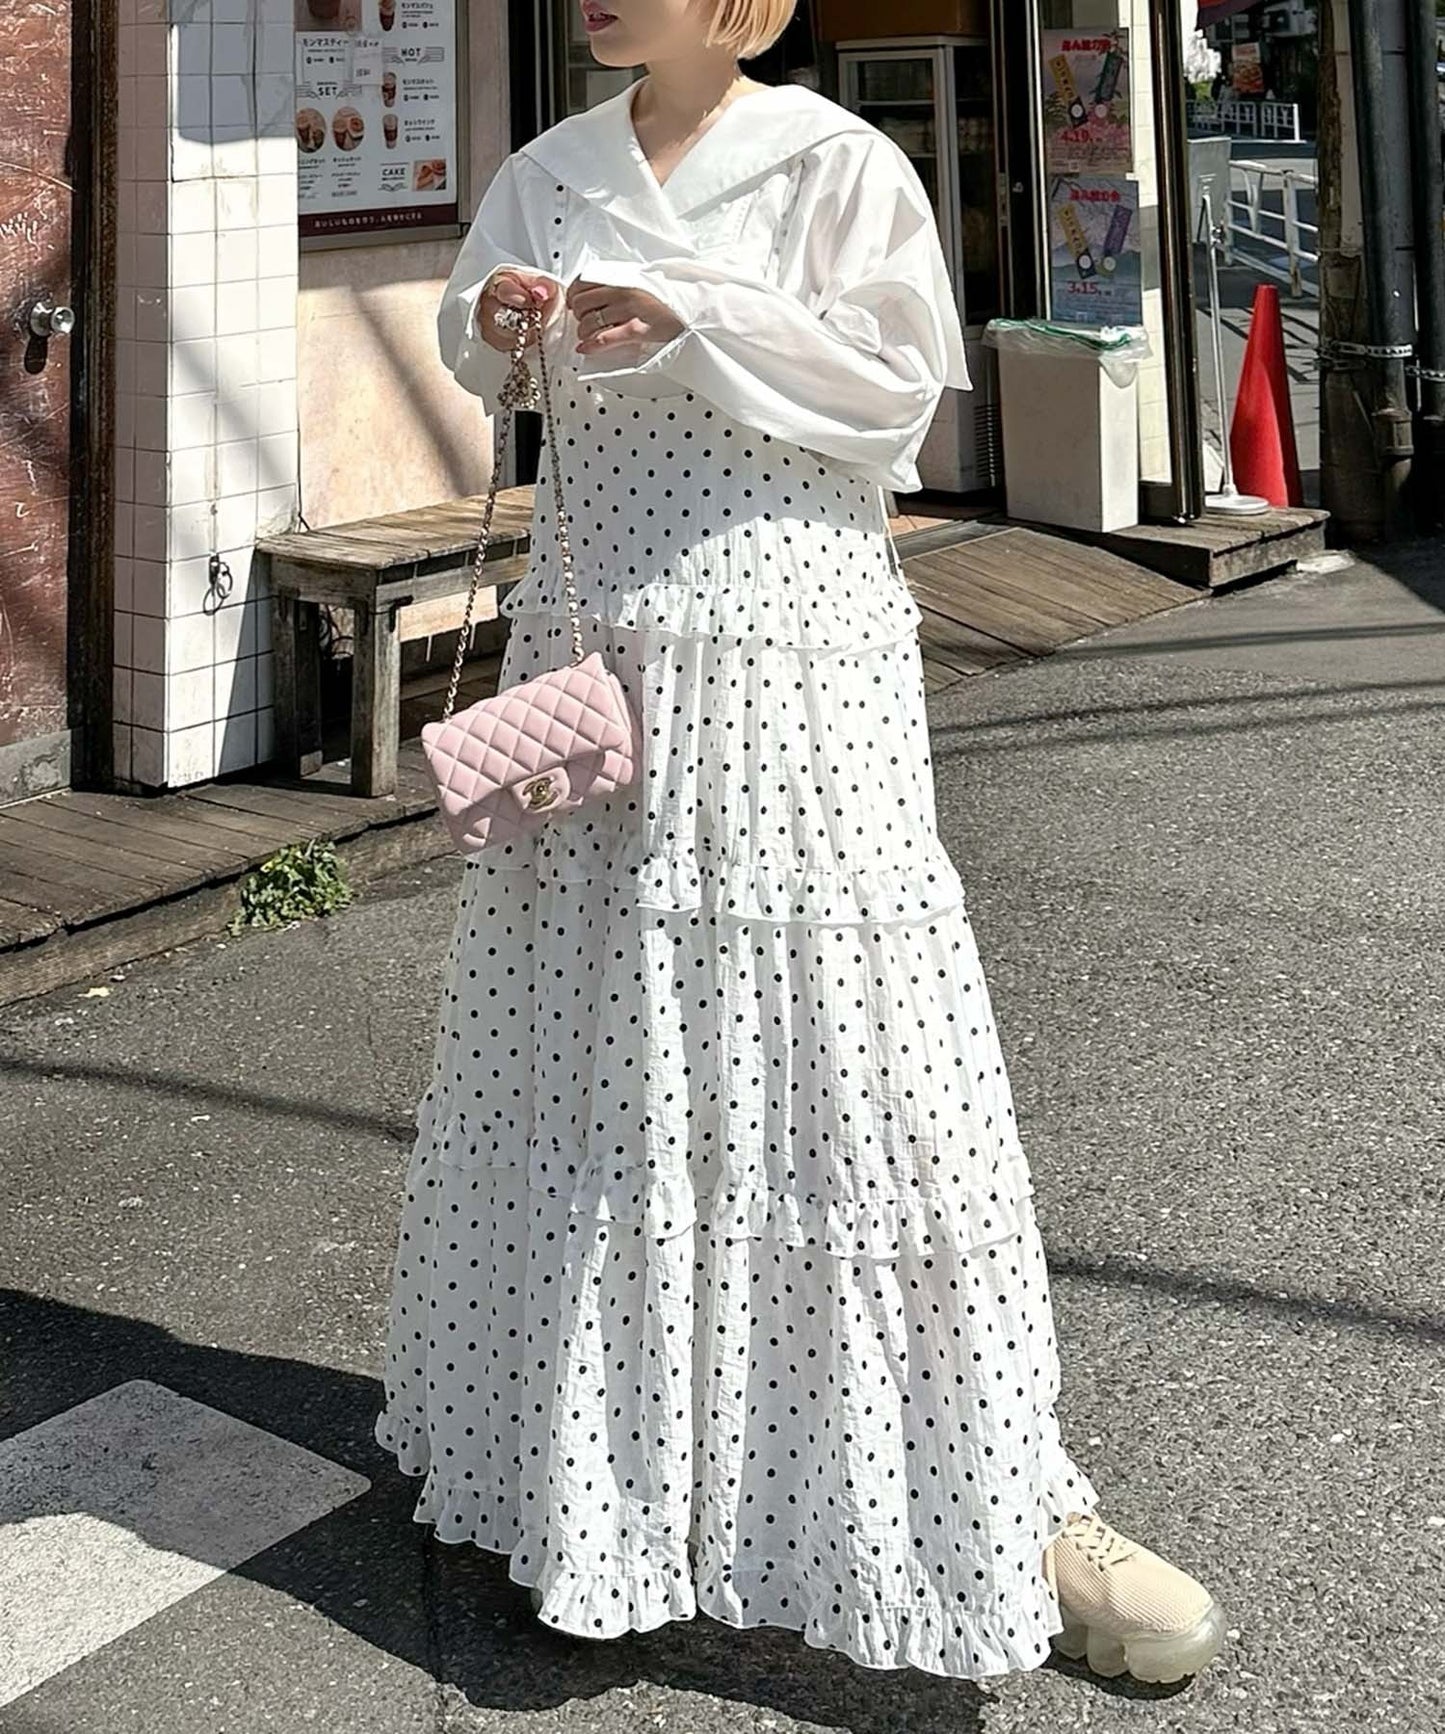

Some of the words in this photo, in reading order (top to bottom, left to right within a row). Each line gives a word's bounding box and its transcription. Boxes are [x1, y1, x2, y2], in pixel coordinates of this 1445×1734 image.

[401, 47, 421, 57] HOT
[318, 86, 338, 97] SET
[382, 167, 406, 176] CAKE
